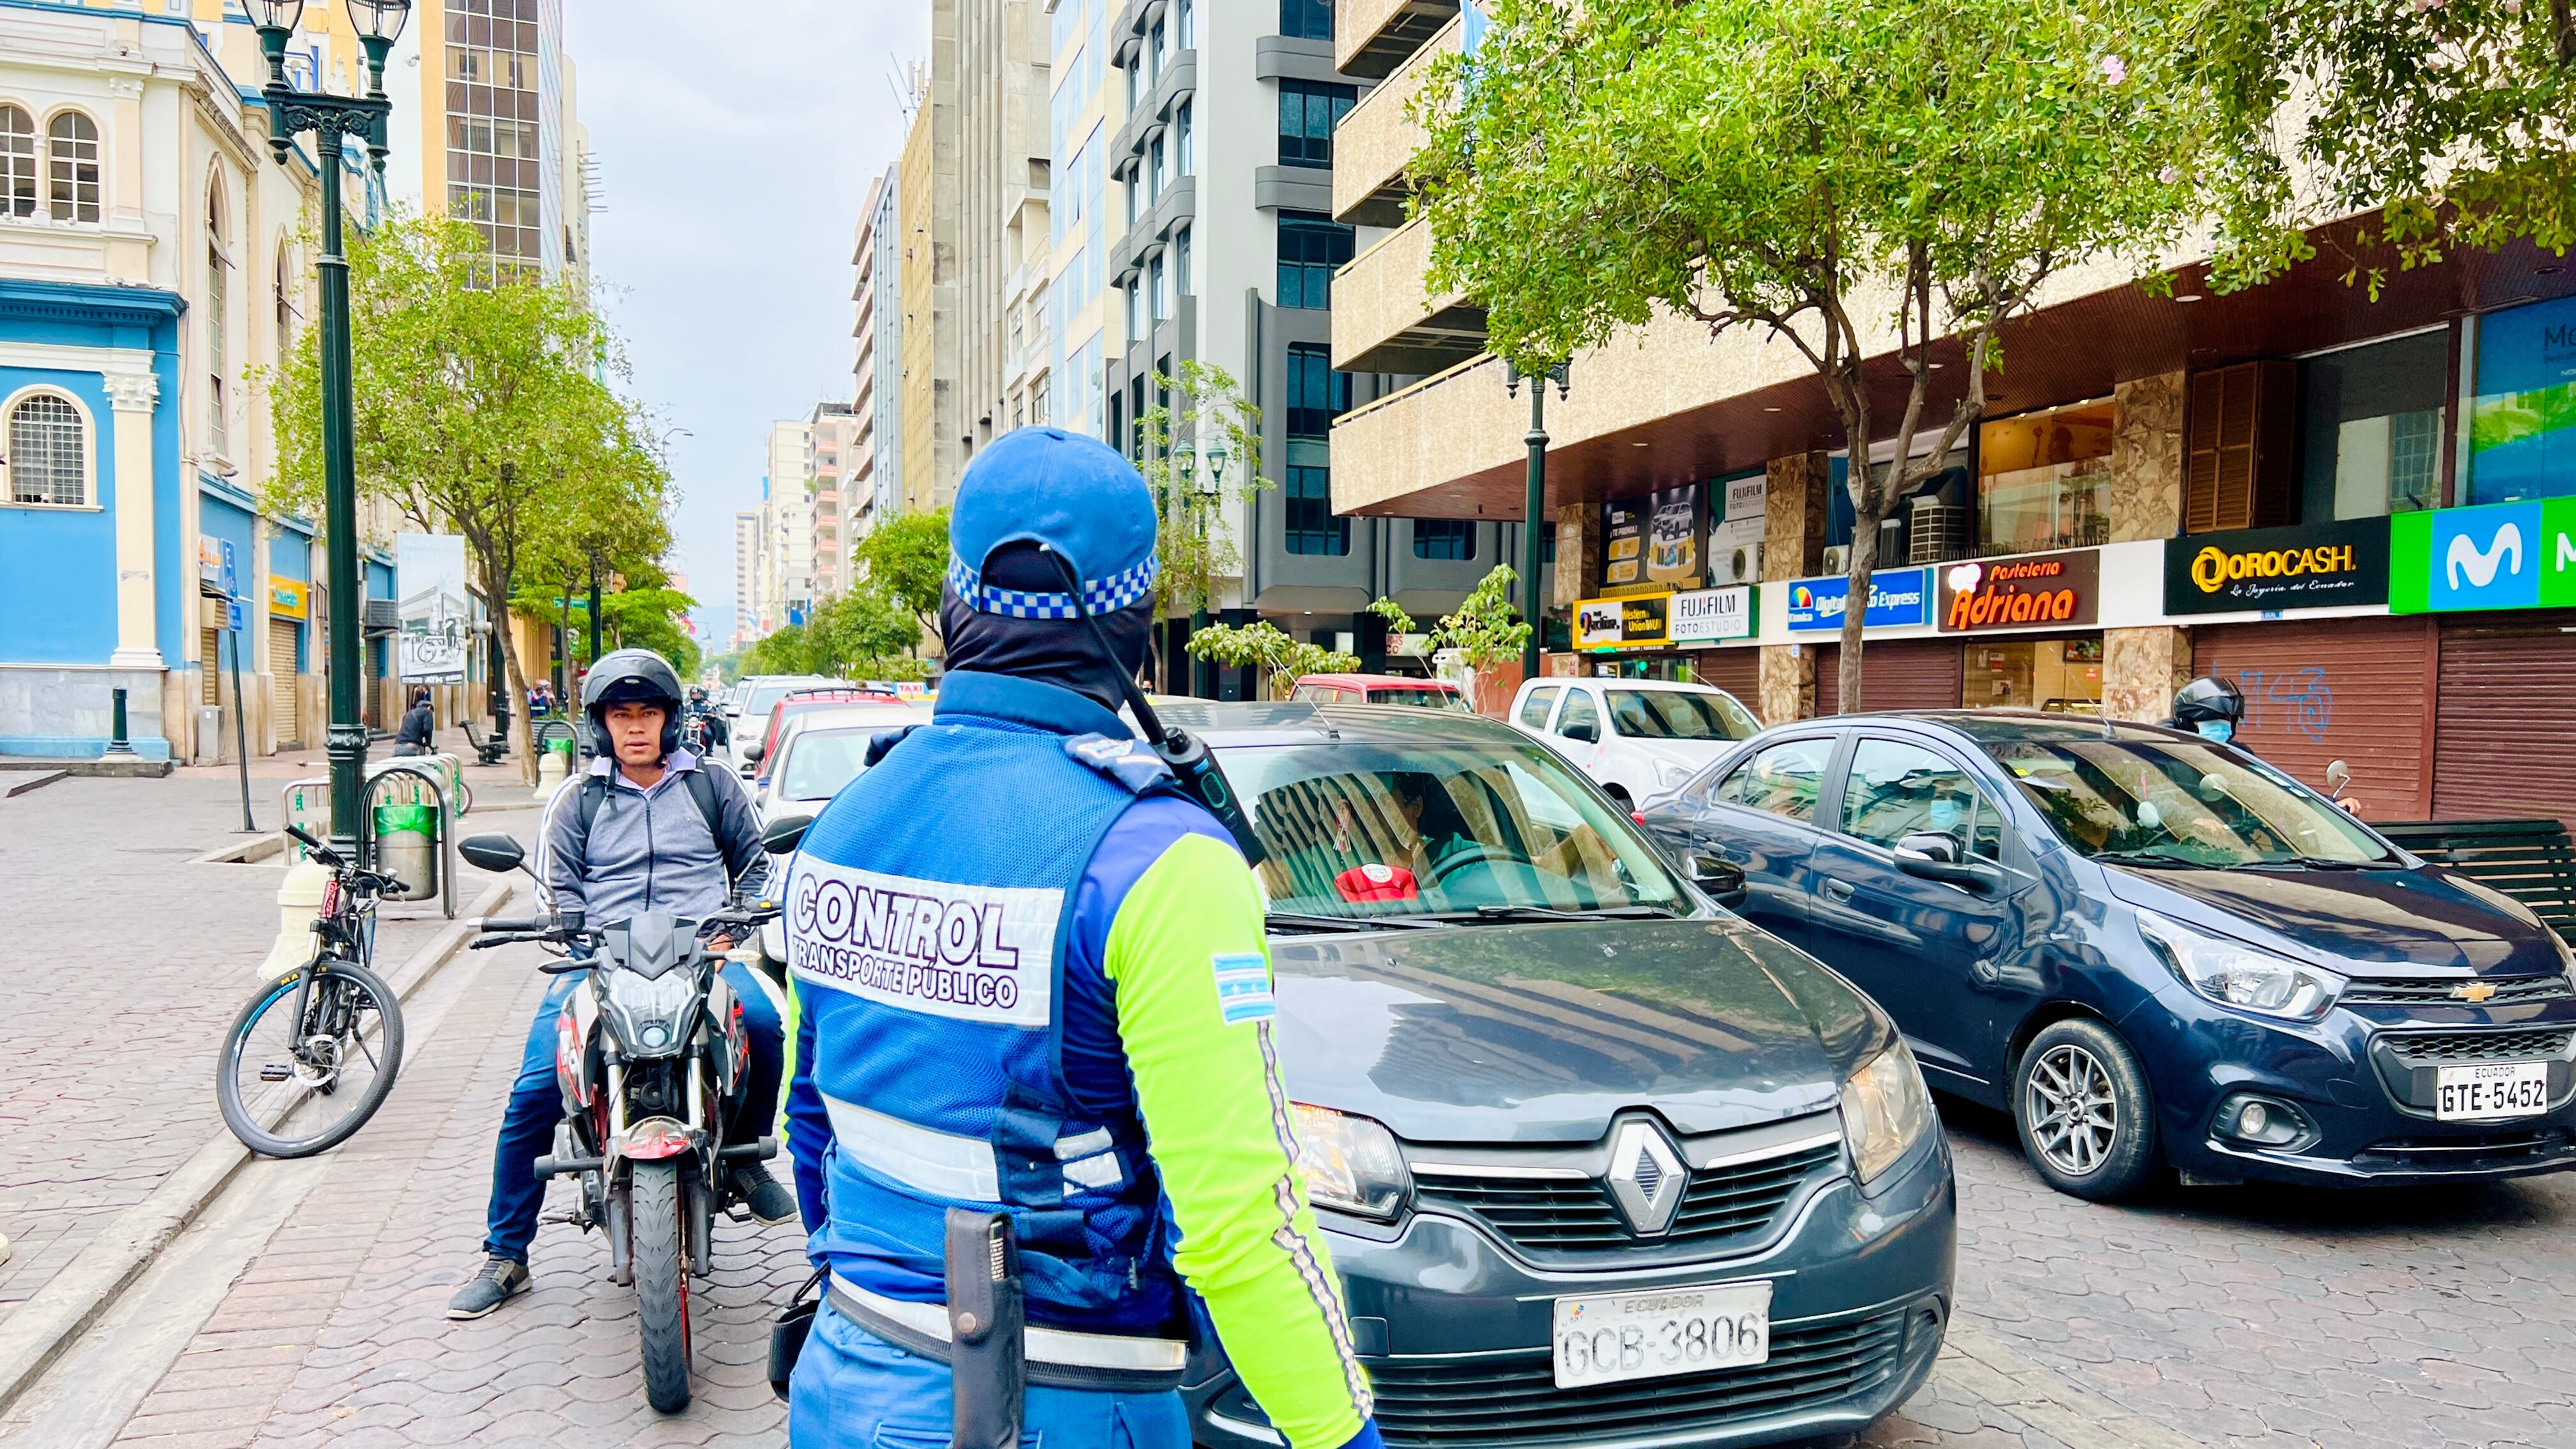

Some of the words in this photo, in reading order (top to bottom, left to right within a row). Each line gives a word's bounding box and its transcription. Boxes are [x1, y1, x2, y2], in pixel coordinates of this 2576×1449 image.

[1733, 484, 1762, 500] FUJIFILM
[1729, 496, 1764, 510] FOTOESTUDIO
[2290, 582, 2306, 591] del
[2309, 579, 2354, 590] Ecuador
[1681, 594, 1736, 617] FUJIFILM
[1878, 591, 1920, 610] Express
[1948, 585, 2076, 631] Adriana
[1622, 609, 1648, 620] Western
[1675, 619, 1741, 634] FOTOESTUDIO
[793, 872, 1019, 970] CONTROL
[792, 935, 905, 993] TRANSPORTE
[907, 959, 1018, 1009] PÚBLICO
[2475, 1066, 2515, 1078] ECUADOR
[2442, 1080, 2544, 1112] GTE-5452
[1625, 1294, 1705, 1314] ECUADOR
[1565, 1312, 1759, 1376] GCB-3806
